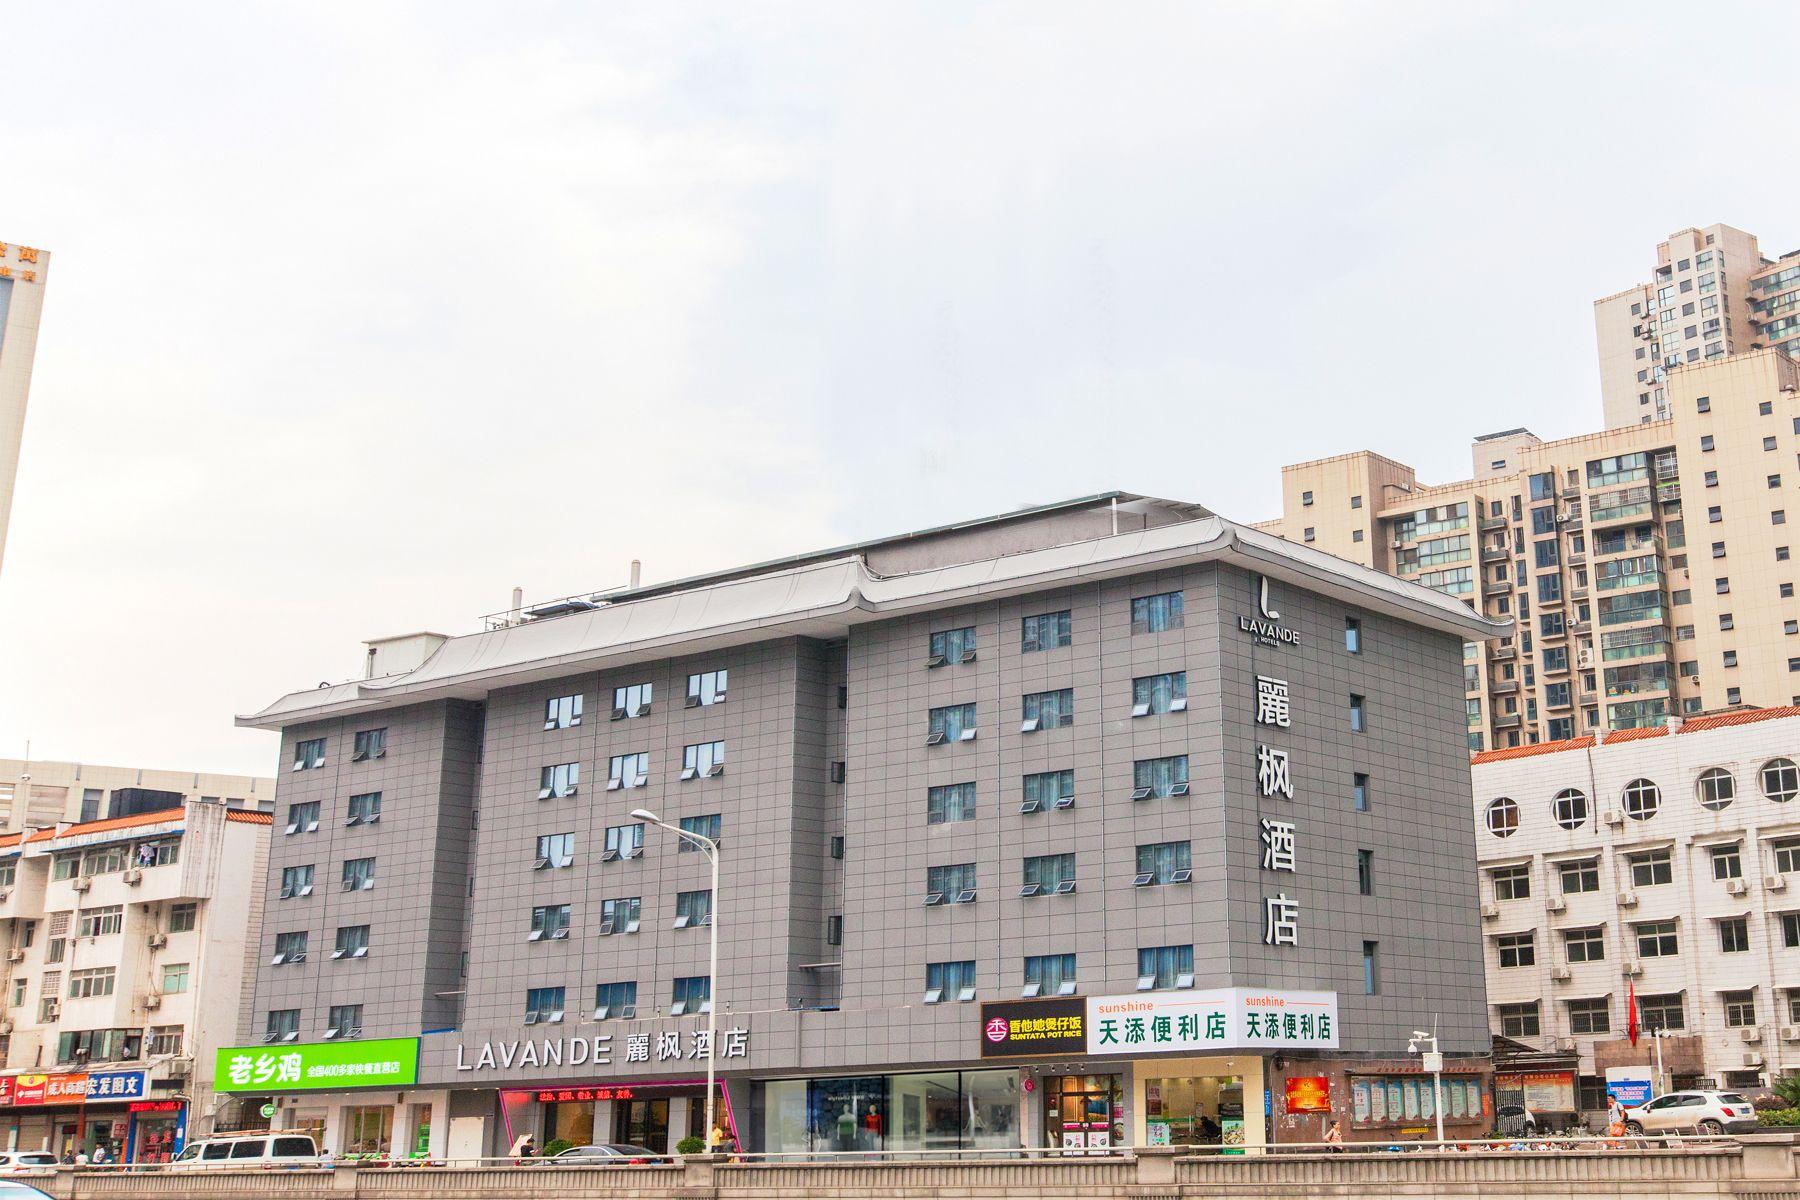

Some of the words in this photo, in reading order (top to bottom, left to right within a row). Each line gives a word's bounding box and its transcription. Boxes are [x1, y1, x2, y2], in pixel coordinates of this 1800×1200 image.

[1240, 616, 1300, 645] LAVANDE
[1260, 636, 1281, 647] HOTELS
[1256, 674, 1299, 946] 麗枫酒店
[1098, 1000, 1154, 1014] sunshine
[1246, 996, 1285, 1007] sunshine
[1009, 1016, 1082, 1033] 香他她煲仔饭
[1010, 1032, 1046, 1041] SUNTATA
[1047, 1031, 1063, 1039] POT
[1064, 1030, 1082, 1038] RICE
[1099, 1011, 1226, 1045] 天添便利店
[1246, 1012, 1331, 1040] 天添便利店
[456, 1035, 612, 1071] LAVANDE
[625, 1027, 749, 1063] 麗枫酒店
[228, 1052, 303, 1085] 老乡鸡
[86, 1076, 139, 1095] 宏发图文
